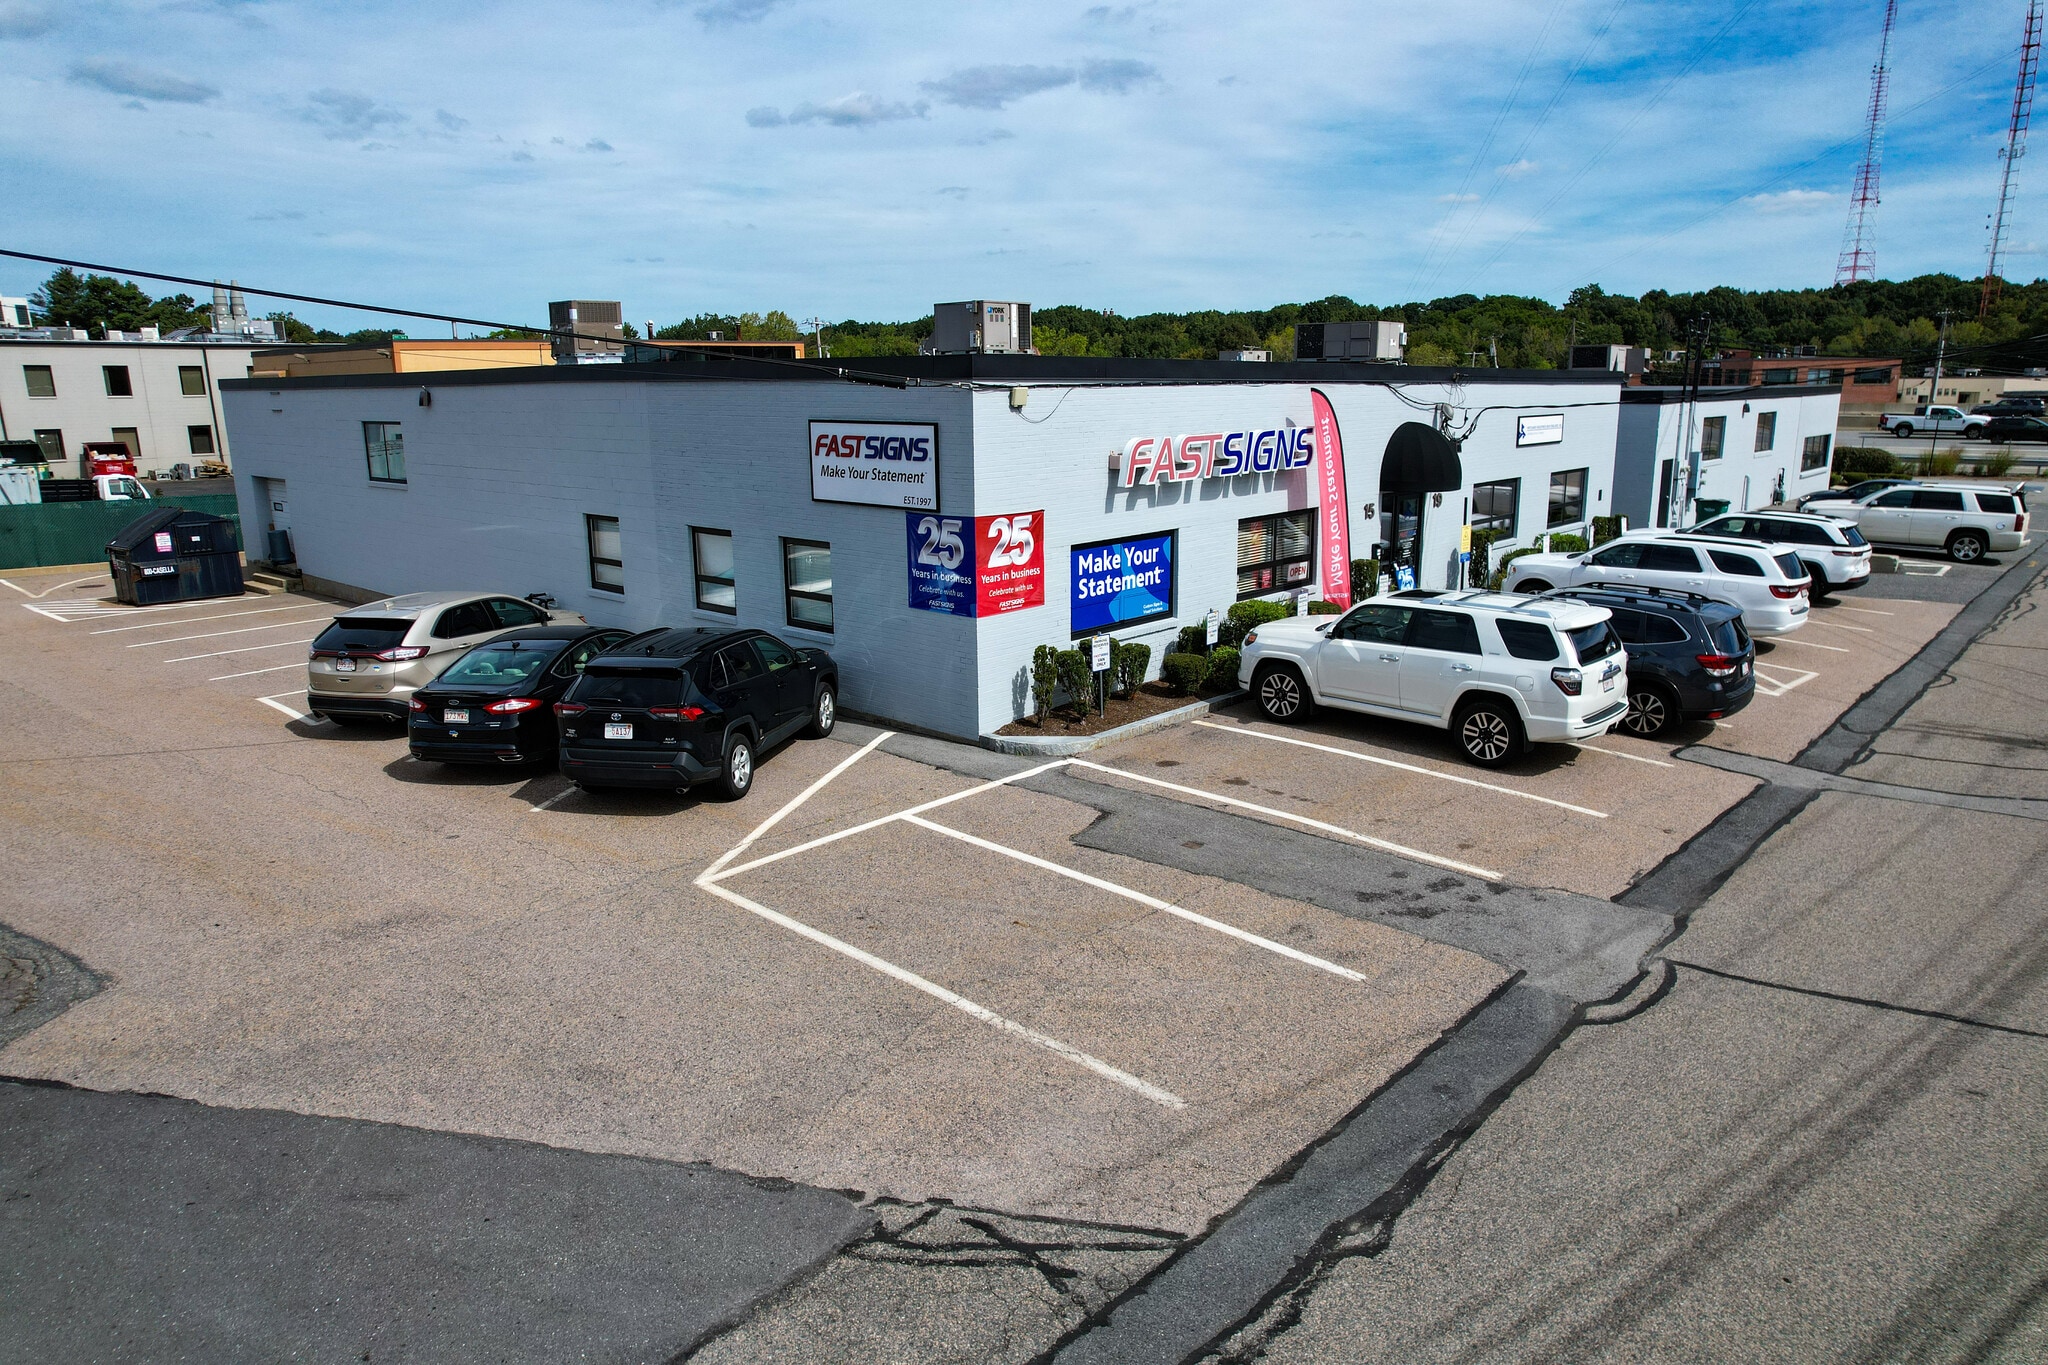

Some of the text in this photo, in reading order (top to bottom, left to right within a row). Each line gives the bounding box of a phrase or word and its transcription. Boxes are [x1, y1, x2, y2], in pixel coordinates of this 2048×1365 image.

[814, 434, 930, 462] FASTSIGNS
[1124, 427, 1314, 488] FASTSIGNS
[820, 464, 925, 484] Make Your Statement
[903, 495, 932, 507] EST.1997
[1363, 503, 1375, 520] 15
[917, 516, 964, 569] 25
[987, 514, 1034, 569] 25
[1078, 545, 1160, 575] Make Your
[911, 567, 972, 584] Years in business
[981, 567, 1040, 584] Years in business
[1290, 565, 1306, 577] OPEN
[918, 584, 943, 595] Celebrate
[943, 588, 956, 596] with
[988, 586, 1014, 597] Celebrate
[1014, 584, 1026, 593] with
[1078, 567, 1161, 599] Statement
